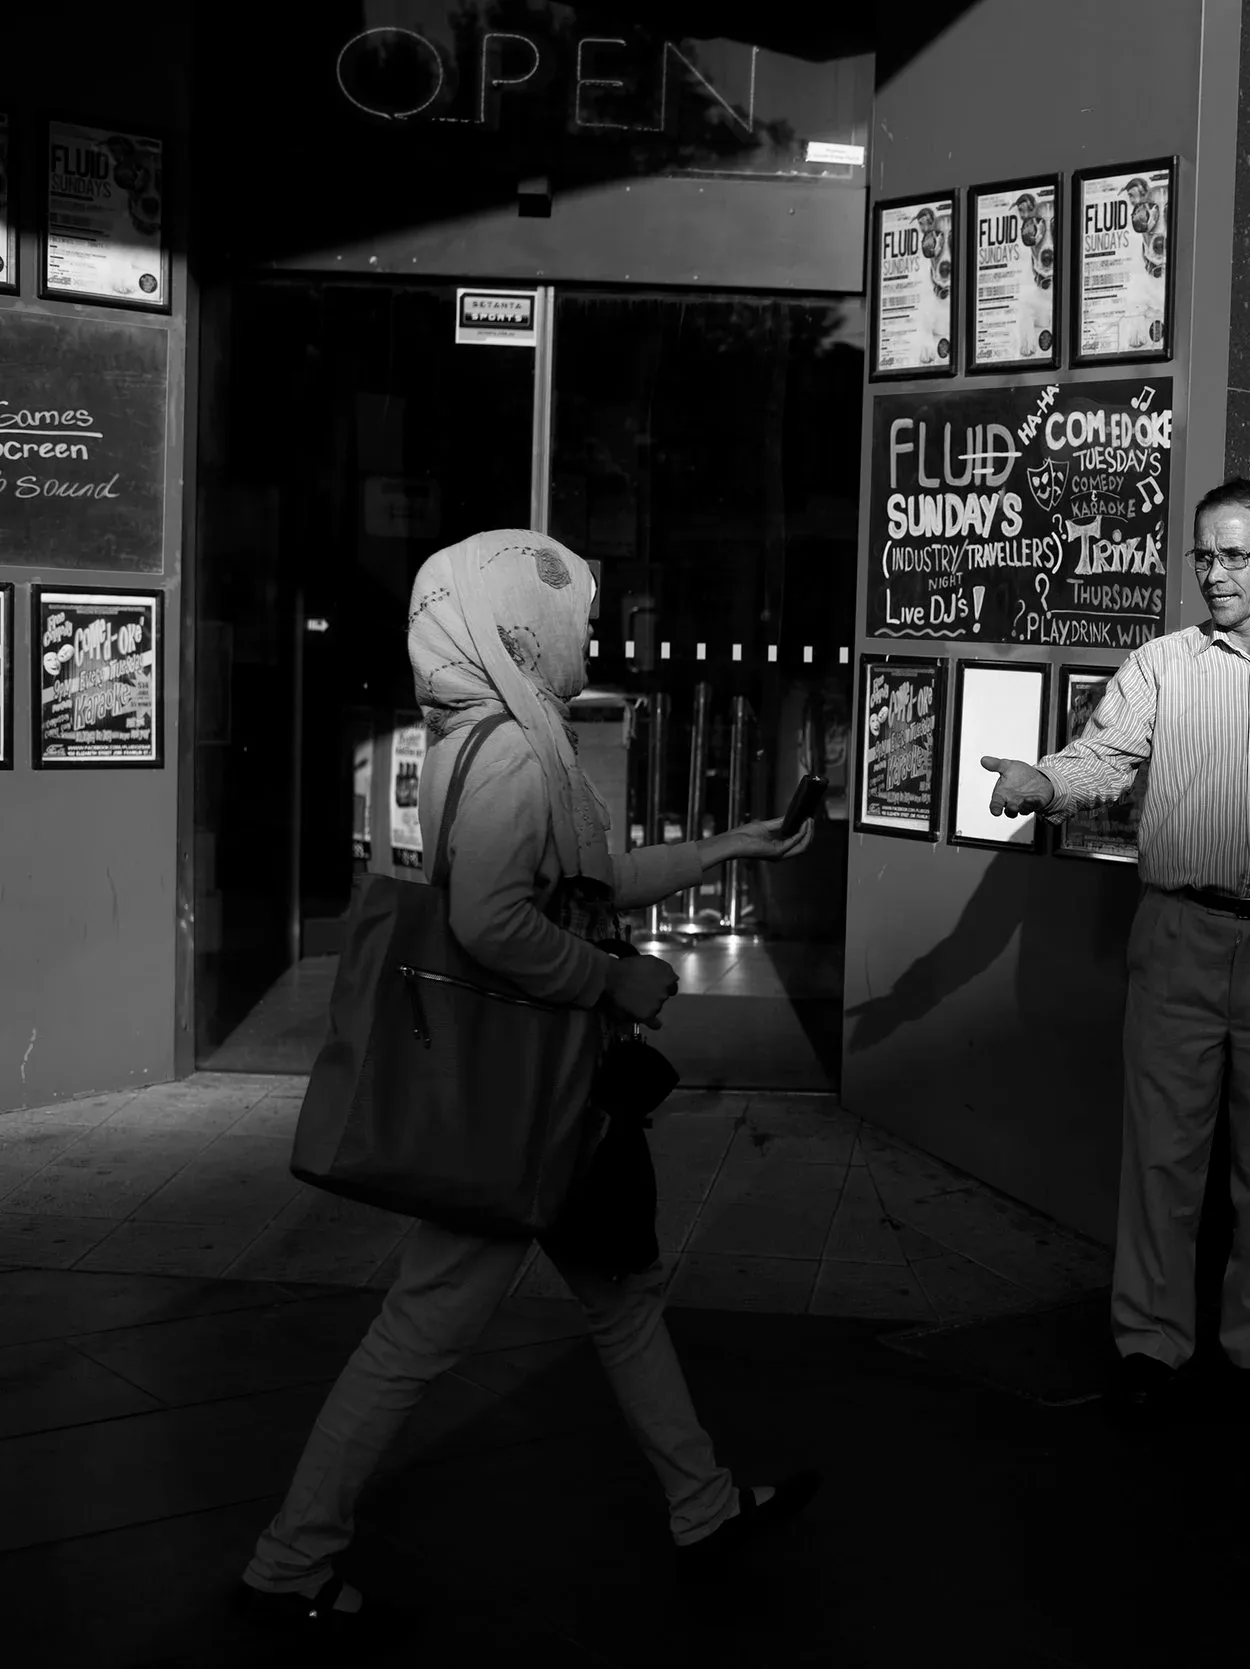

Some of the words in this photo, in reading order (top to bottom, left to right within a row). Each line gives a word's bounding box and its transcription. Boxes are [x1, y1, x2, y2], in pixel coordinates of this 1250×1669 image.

[336, 27, 758, 133] OPEN
[51, 145, 109, 180] FLUID
[51, 173, 112, 199] SUNDAYS
[1085, 200, 1128, 234] FLUID
[978, 215, 1018, 248] FLUID
[1085, 230, 1129, 253] SUNDAYS
[883, 228, 919, 260] FLUID
[978, 243, 1020, 265] SUNDAYS
[883, 255, 920, 276] SUNDAYS
[472, 301, 522, 310] SETANTA
[890, 417, 1016, 489] FLUID
[1071, 474, 1124, 493] COMEDY
[1071, 499, 1137, 519] KARAOKE
[928, 572, 963, 591] NIGHT
